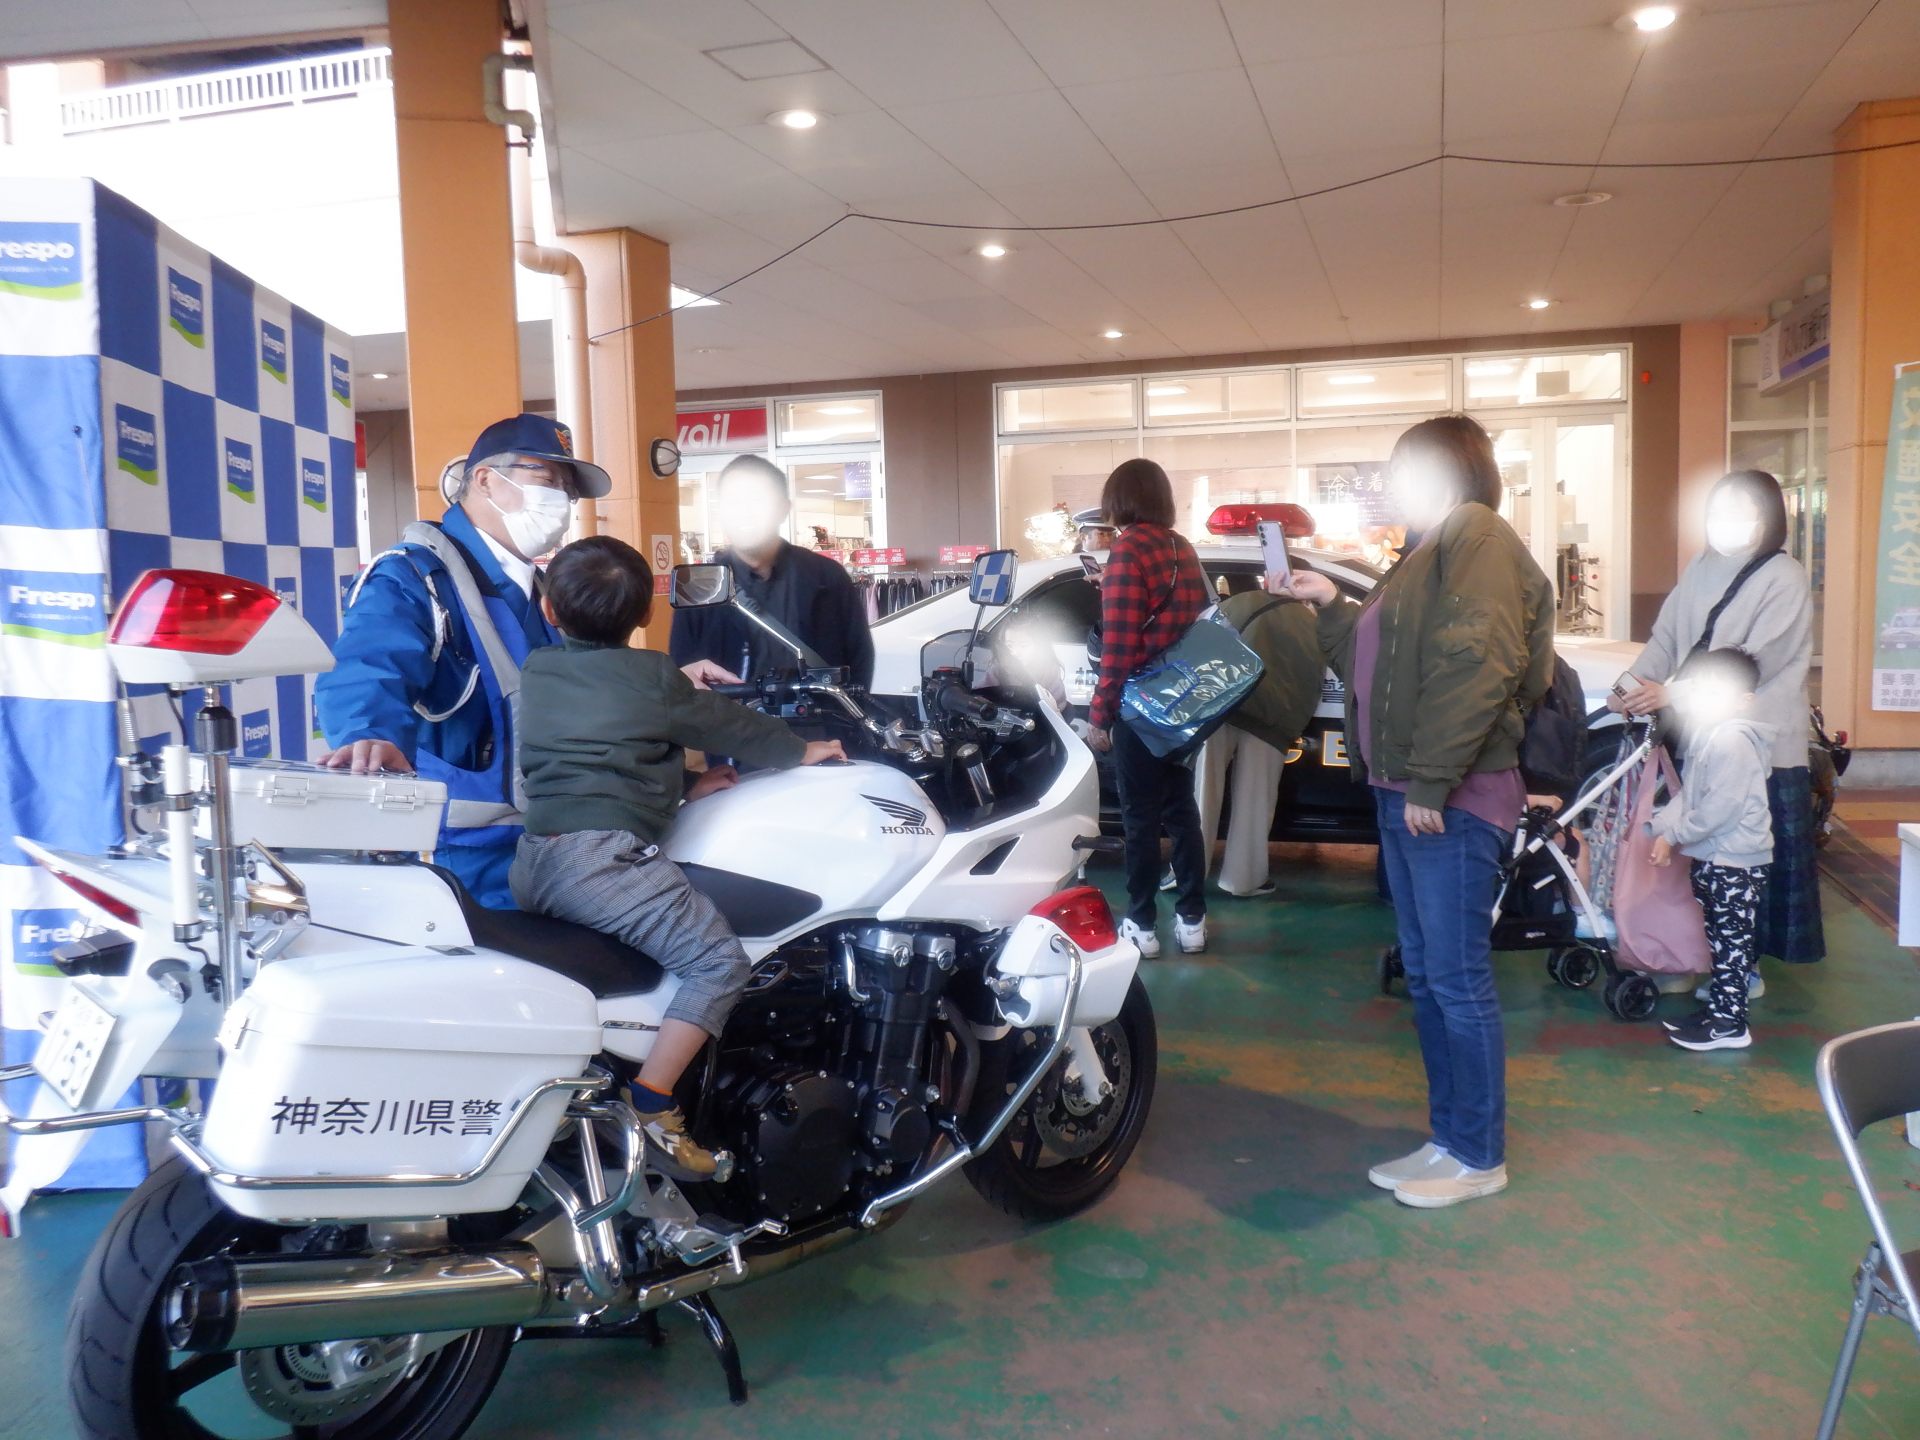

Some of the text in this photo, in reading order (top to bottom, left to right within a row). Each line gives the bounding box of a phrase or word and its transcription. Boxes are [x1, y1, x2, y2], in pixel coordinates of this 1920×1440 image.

[0, 242, 75, 262] respo
[119, 420, 156, 446] Frespo
[227, 451, 252, 473] Frespo
[304, 469, 325, 486] Frespo
[244, 724, 270, 742] Frespo
[880, 826, 936, 836] HONDA
[21, 925, 81, 943] Fre
[271, 1095, 503, 1137] 神奈川県警
